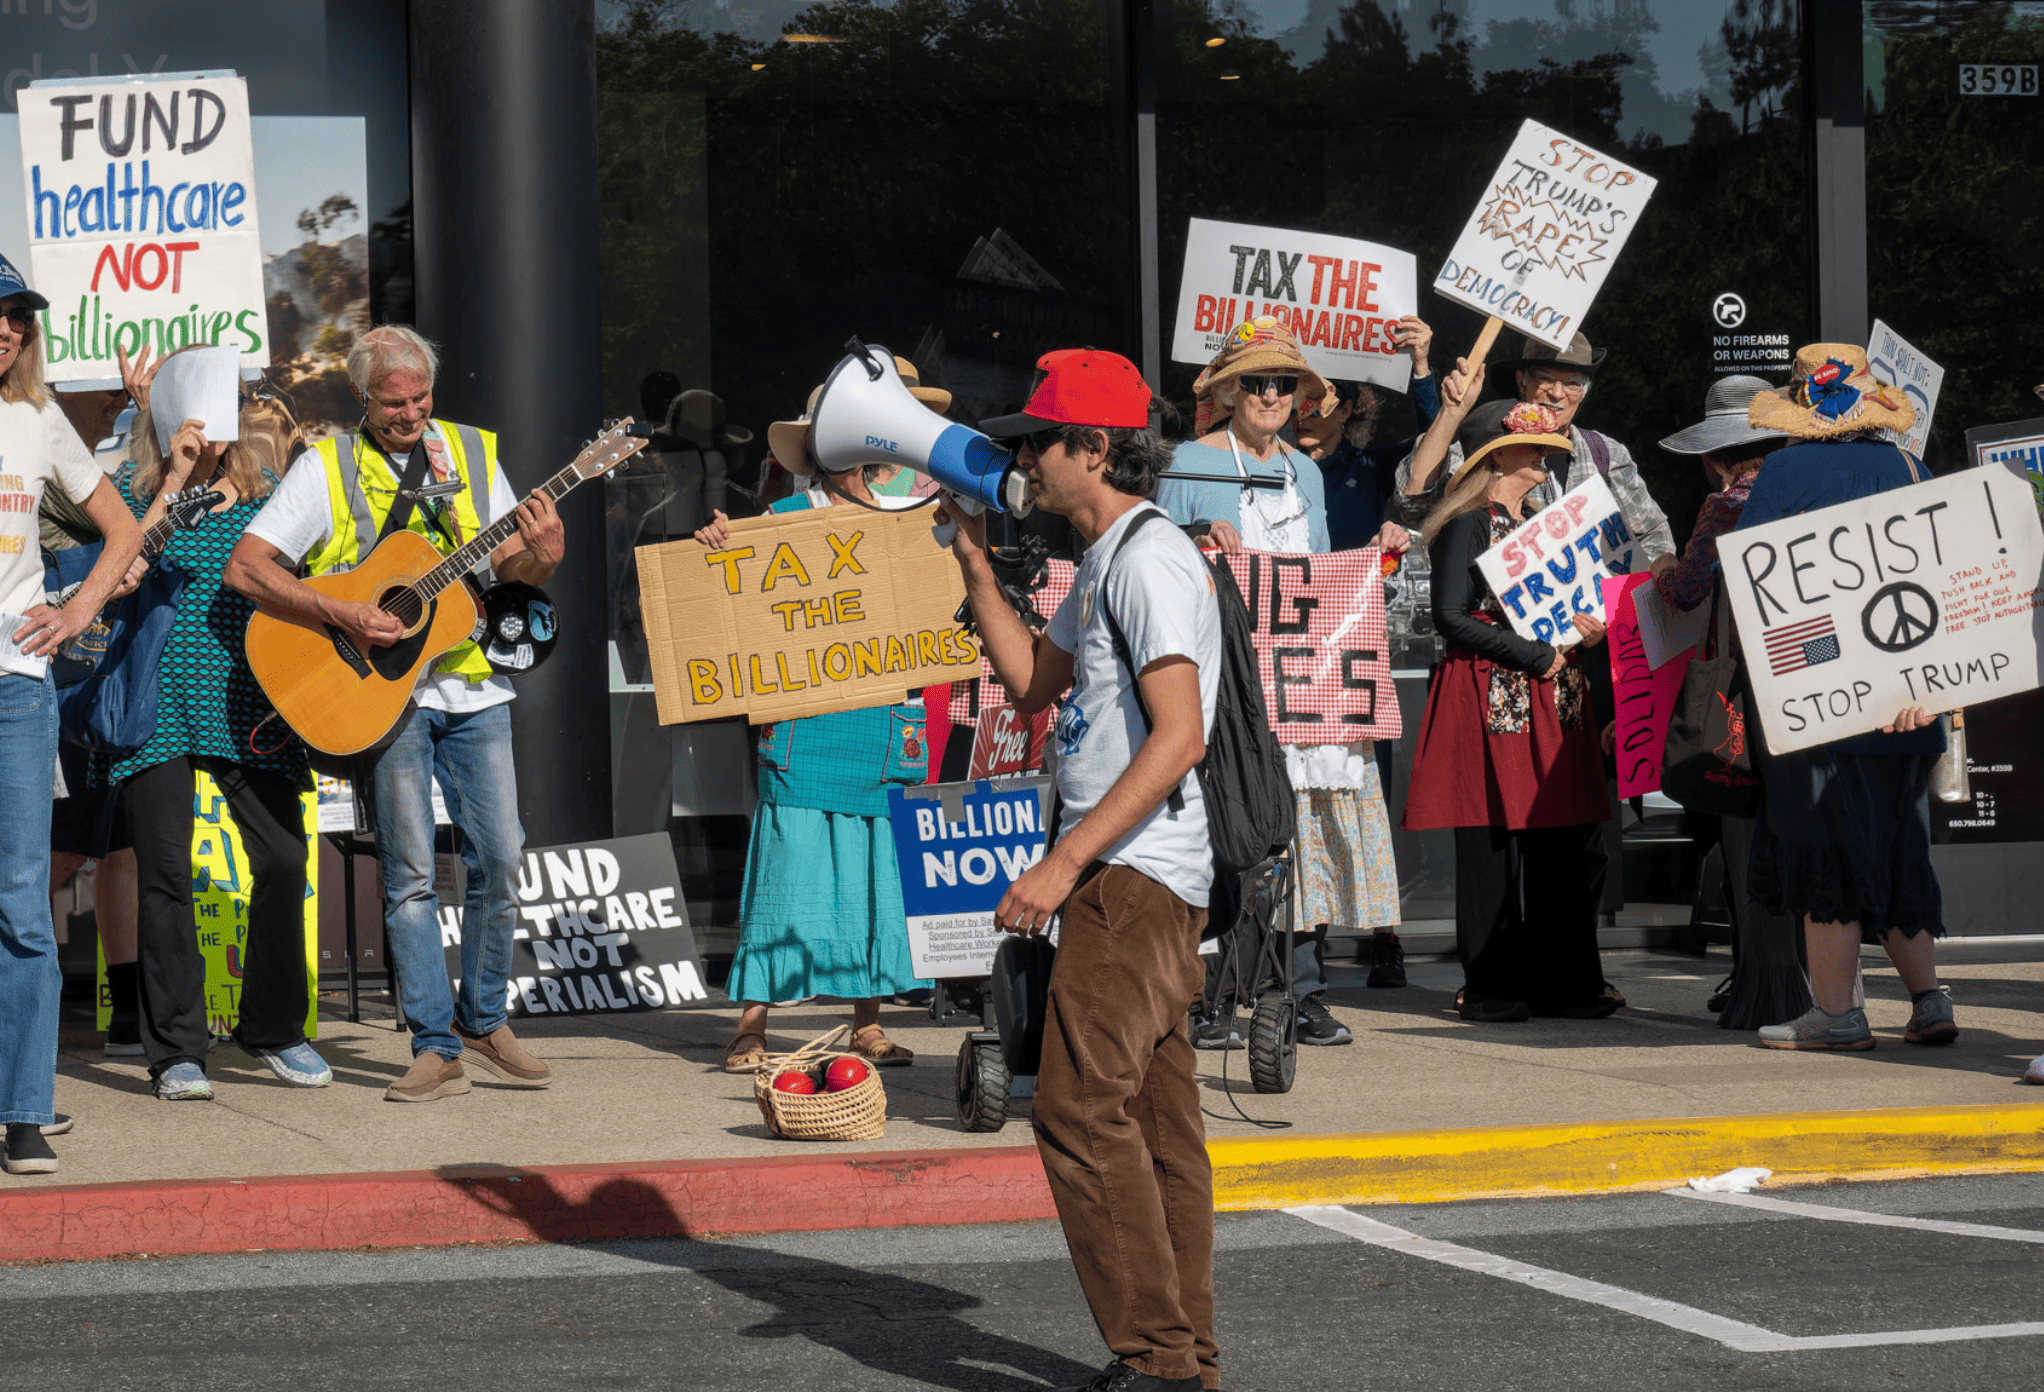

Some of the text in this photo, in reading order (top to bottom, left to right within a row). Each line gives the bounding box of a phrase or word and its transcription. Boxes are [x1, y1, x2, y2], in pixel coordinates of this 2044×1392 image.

[1961, 66, 2036, 93] 359B
[50, 87, 226, 162] FUND
[1539, 138, 1635, 192] STOP
[31, 159, 247, 239] healthcare
[1506, 158, 1628, 235] TRUMP'S
[1493, 199, 1584, 260] RAPE
[90, 241, 200, 294] NOT
[1229, 244, 1382, 313] TAX THE
[1500, 249, 1544, 275] OF
[1438, 258, 1571, 340] DEMOCRACY!
[41, 293, 262, 364] billionaires
[1713, 334, 1790, 346] NO FIREARMS
[1713, 348, 1790, 360] OR WEAPONS
[865, 435, 898, 452] PYLE
[0, 493, 36, 514] NTRY
[1501, 494, 1589, 580] STOP
[704, 530, 869, 595] TAX
[1499, 510, 1632, 620] TRUTH
[1741, 500, 1948, 627] RESIST
[1948, 565, 1983, 586] STAND
[1941, 570, 2017, 600] PUSH BACK AND
[1944, 586, 2011, 612] FIGHT FOR OUR
[1990, 594, 2013, 609] KEEP
[771, 589, 866, 632] THE
[686, 627, 979, 706] BILLIONAIRES
[1782, 652, 2010, 732] STOP TRUMP
[987, 708, 1029, 772] Free
[1966, 765, 1990, 773] Center,
[916, 799, 1046, 842] BILLION
[922, 843, 1046, 888] NOW
[922, 920, 934, 929] Ad
[935, 919, 953, 930] paid
[954, 917, 966, 927] for
[967, 917, 979, 928] by
[928, 929, 973, 941] Sponsored
[974, 928, 985, 939] by
[531, 932, 630, 971] NOT
[922, 952, 968, 963] Employees
[928, 940, 973, 951] Healthcare
